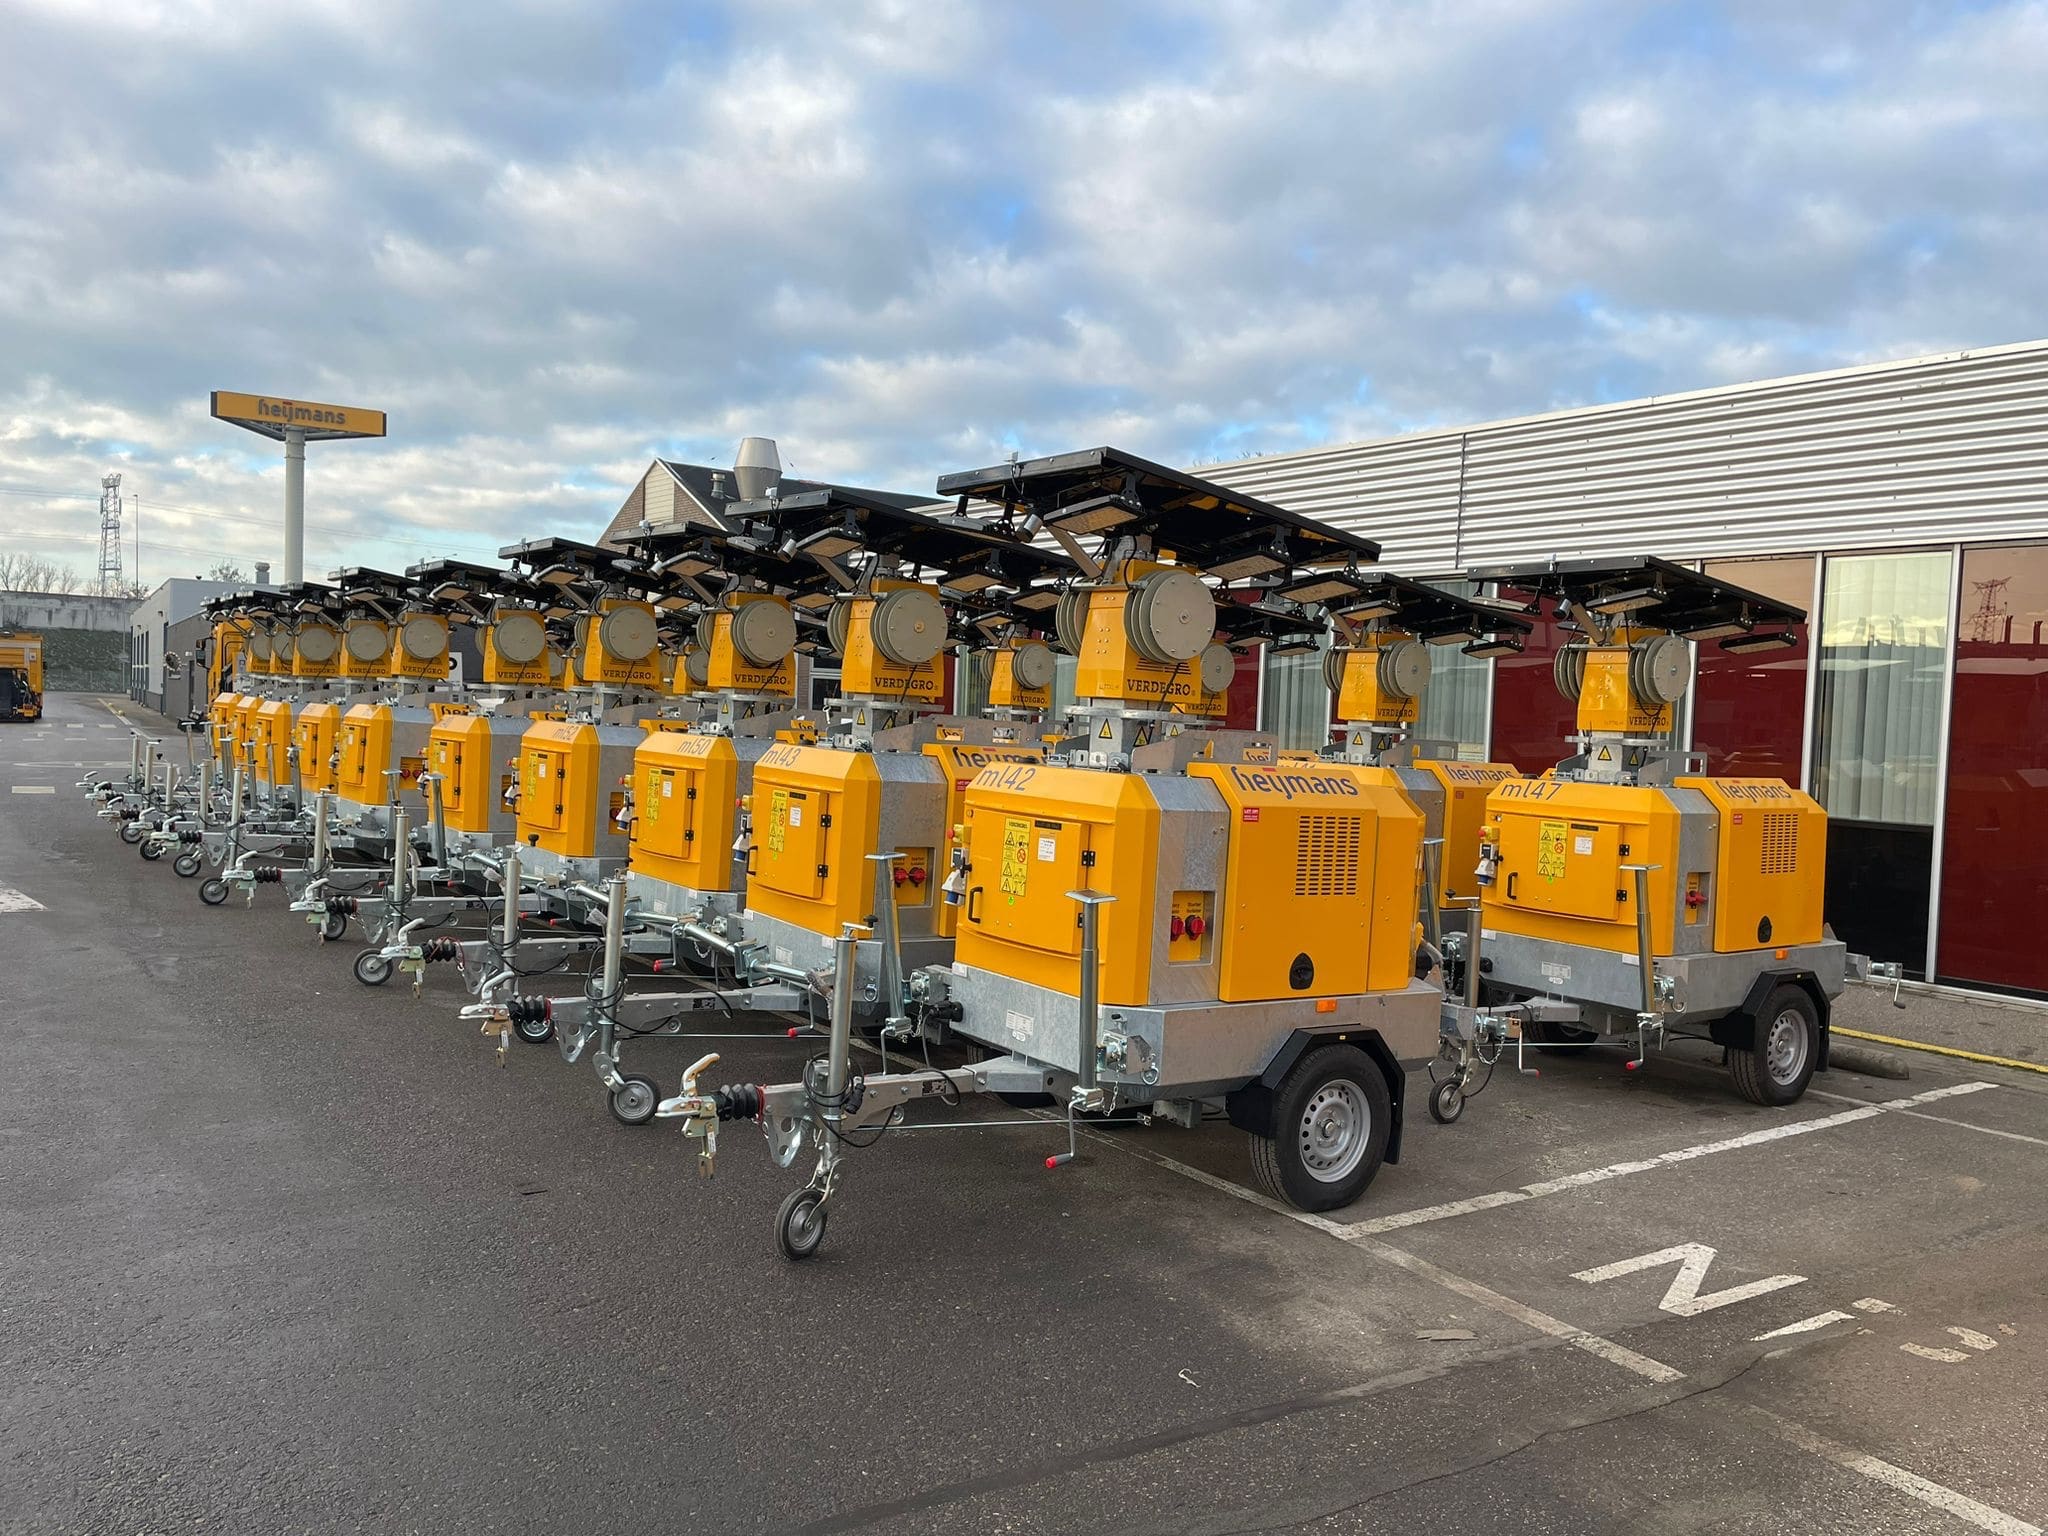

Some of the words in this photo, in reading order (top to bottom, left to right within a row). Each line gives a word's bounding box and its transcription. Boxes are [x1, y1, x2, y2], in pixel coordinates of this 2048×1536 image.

[258, 399, 346, 424] heijmans
[497, 671, 542, 680] VERDEGRO
[603, 669, 651, 680] VERDEGRO
[734, 674, 787, 685] VERDEGRO
[875, 677, 934, 690] VERDEGRO
[1127, 679, 1192, 696] VERDEGRO
[1629, 716, 1667, 726] VERDEGRO
[677, 739, 712, 755] ml50
[762, 746, 802, 767] ml43
[976, 765, 1037, 791] ml42
[1231, 766, 1358, 799] heijmans
[1500, 781, 1563, 800] ml47
[1715, 780, 1792, 803] heijmans
